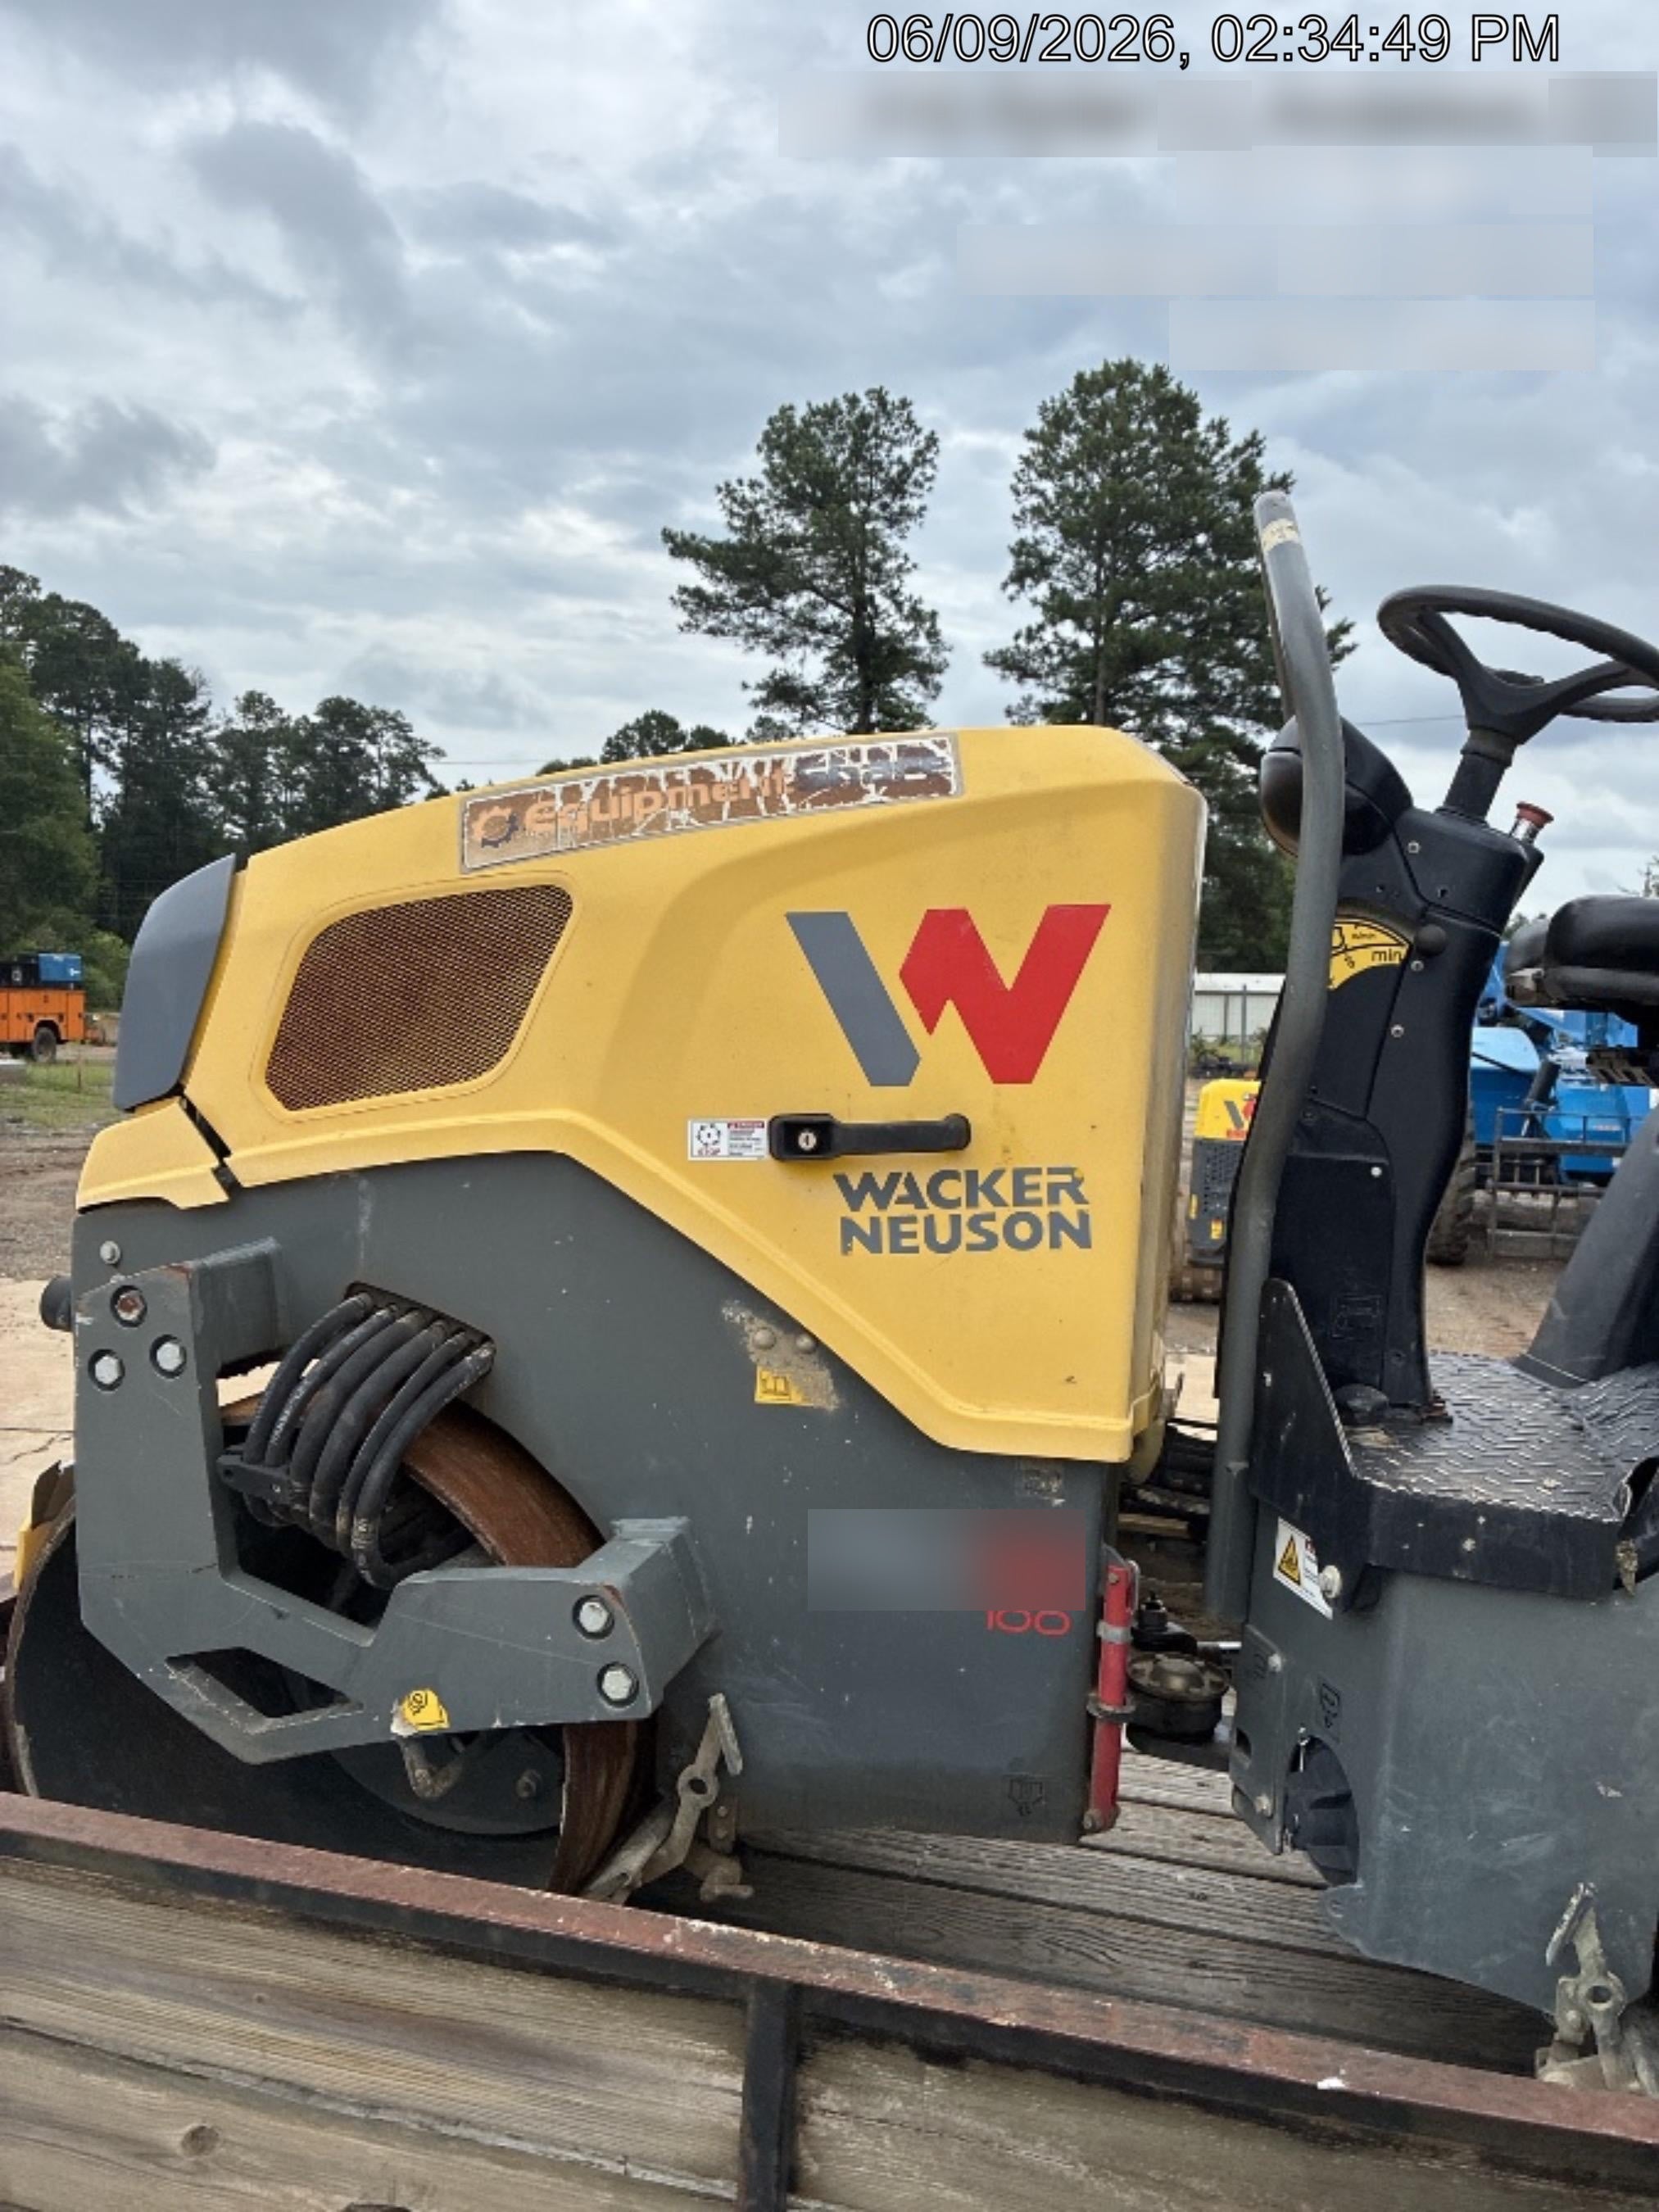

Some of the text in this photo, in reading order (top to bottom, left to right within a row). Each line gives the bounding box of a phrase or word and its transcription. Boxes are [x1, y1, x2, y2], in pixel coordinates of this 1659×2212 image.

[1371, 949, 1402, 962] min
[833, 1166, 1090, 1211] WACKER
[840, 1210, 1092, 1256] NEUSON
